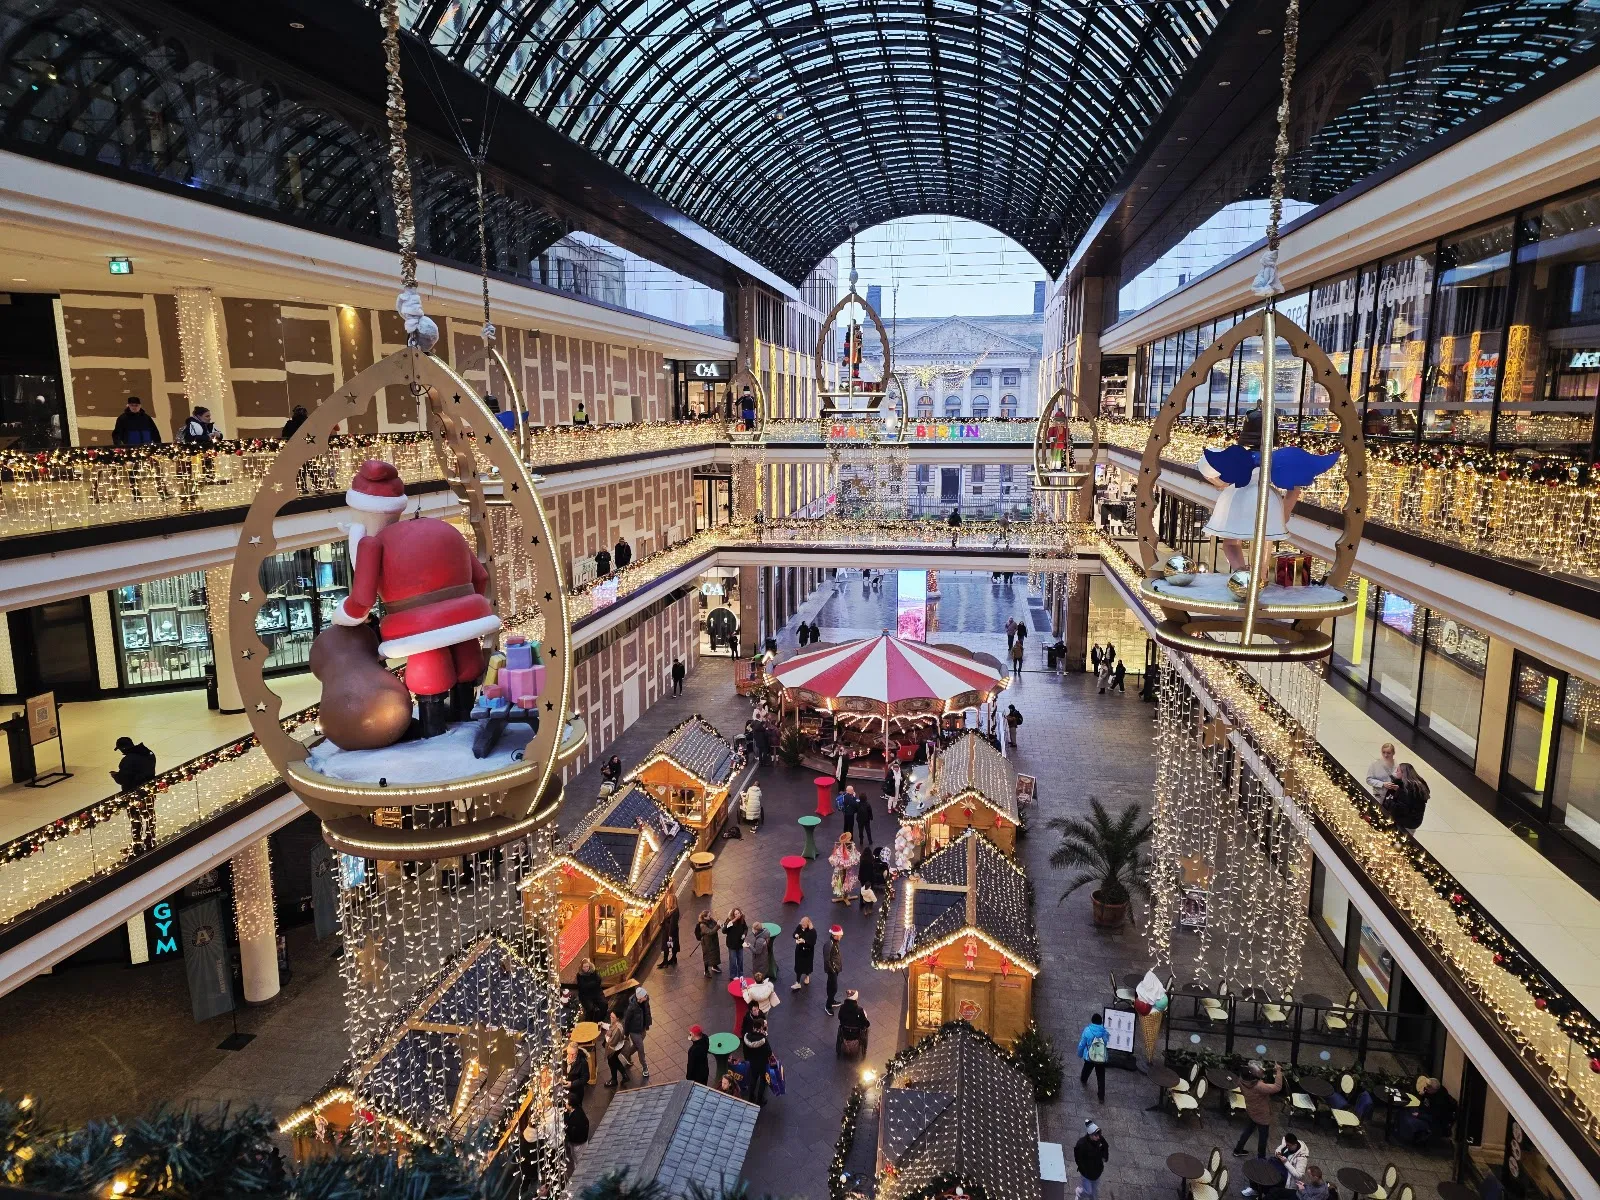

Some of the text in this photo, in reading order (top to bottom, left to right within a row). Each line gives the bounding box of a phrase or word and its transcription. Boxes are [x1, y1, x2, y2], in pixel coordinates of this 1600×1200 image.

[695, 362, 720, 377] C&A
[916, 424, 980, 438] BERLIN
[191, 886, 222, 897] EINGANG
[153, 902, 178, 955] GYM
